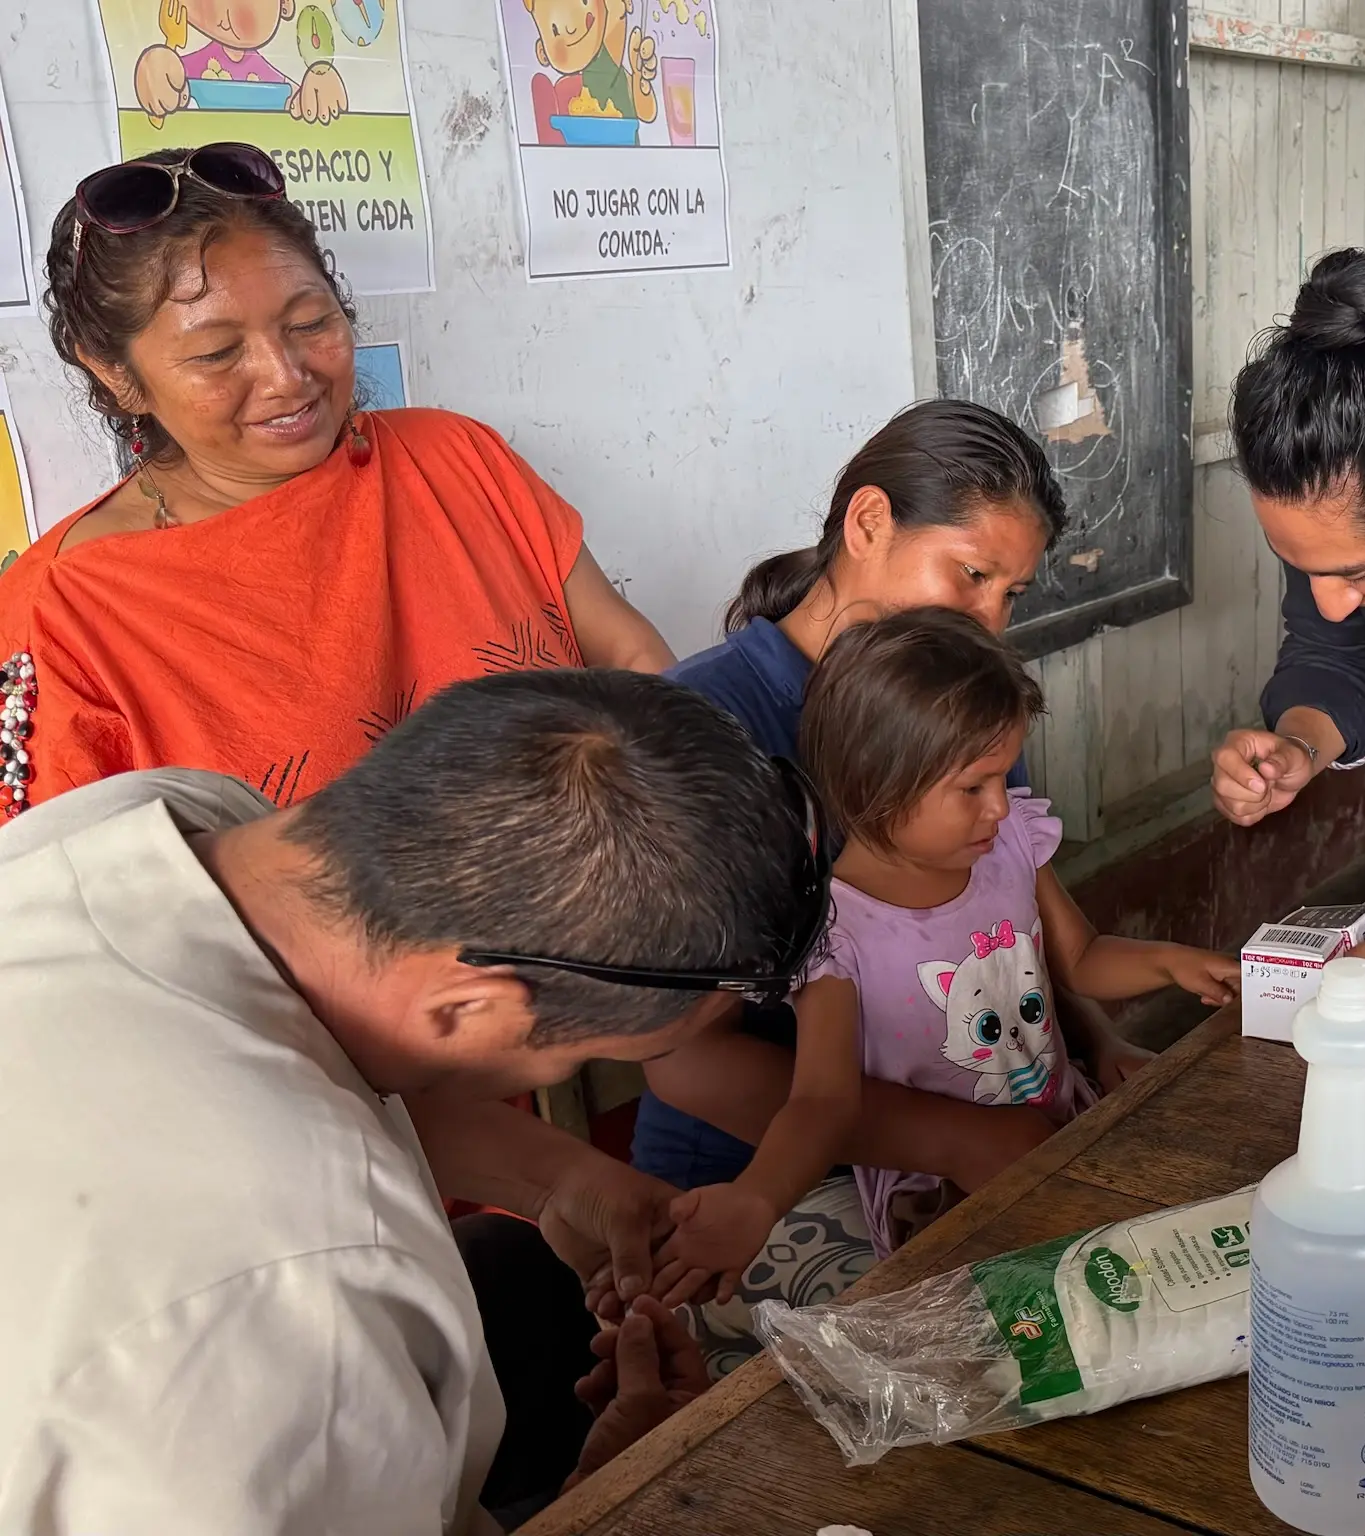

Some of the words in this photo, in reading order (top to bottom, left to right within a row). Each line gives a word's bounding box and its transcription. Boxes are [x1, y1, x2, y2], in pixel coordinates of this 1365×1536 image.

[378, 150, 393, 183] Y
[553, 189, 579, 219] NO
[586, 187, 641, 218] JUGAR
[647, 188, 680, 216] CON
[686, 187, 705, 214] LA
[357, 198, 414, 231] CADA
[598, 229, 669, 258] COMIDA.
[1244, 953, 1256, 962] 201
[1272, 985, 1284, 994] 201
[1285, 986, 1296, 994] Hb
[1150, 1247, 1166, 1268] Superior
[1303, 1381, 1333, 1391] producto
[1301, 1396, 1313, 1404] LOS
[1313, 1459, 1331, 1469] 0190
